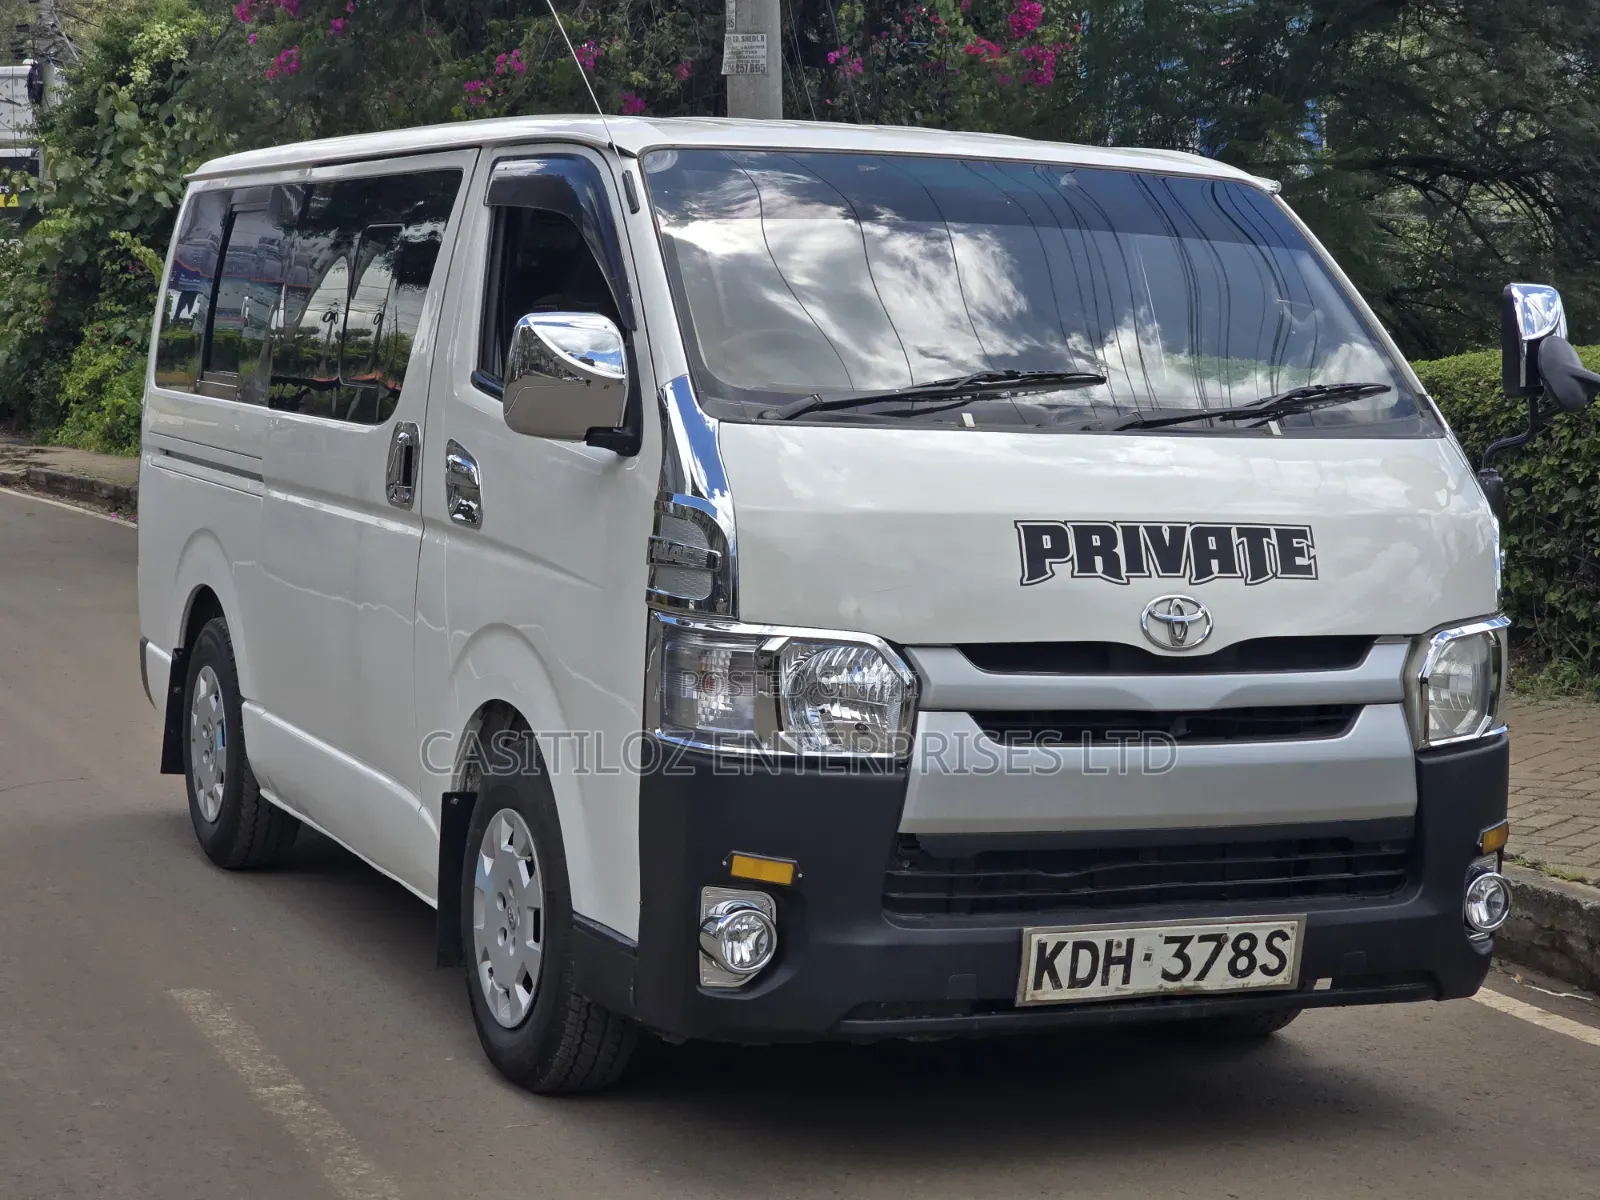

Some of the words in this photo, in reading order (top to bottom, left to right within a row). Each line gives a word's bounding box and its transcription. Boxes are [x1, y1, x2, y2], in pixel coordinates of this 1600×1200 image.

[1014, 520, 1319, 586] PRIVATE
[1032, 937, 1136, 991] KDH
[1160, 929, 1292, 983] 378S
